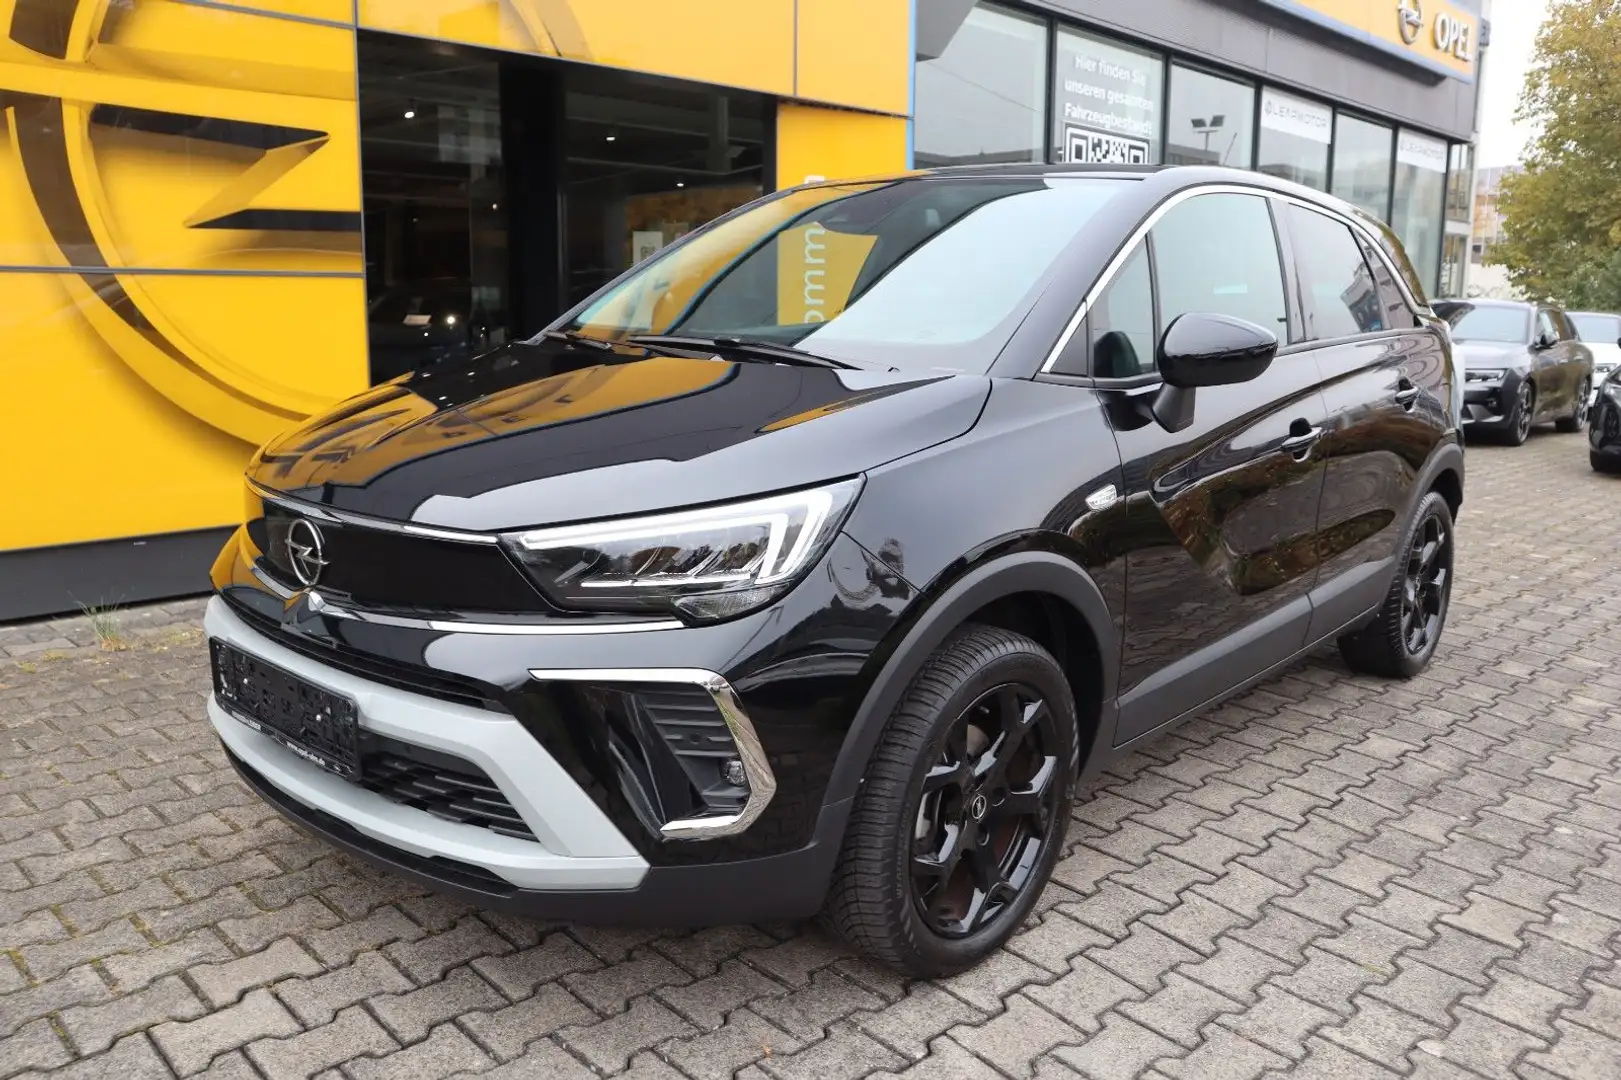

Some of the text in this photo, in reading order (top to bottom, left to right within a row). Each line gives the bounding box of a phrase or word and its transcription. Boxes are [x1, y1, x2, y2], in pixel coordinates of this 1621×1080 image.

[1433, 11, 1472, 61] OPEL
[1075, 54, 1146, 86] Hier finden Sie
[1065, 79, 1105, 100] unseren
